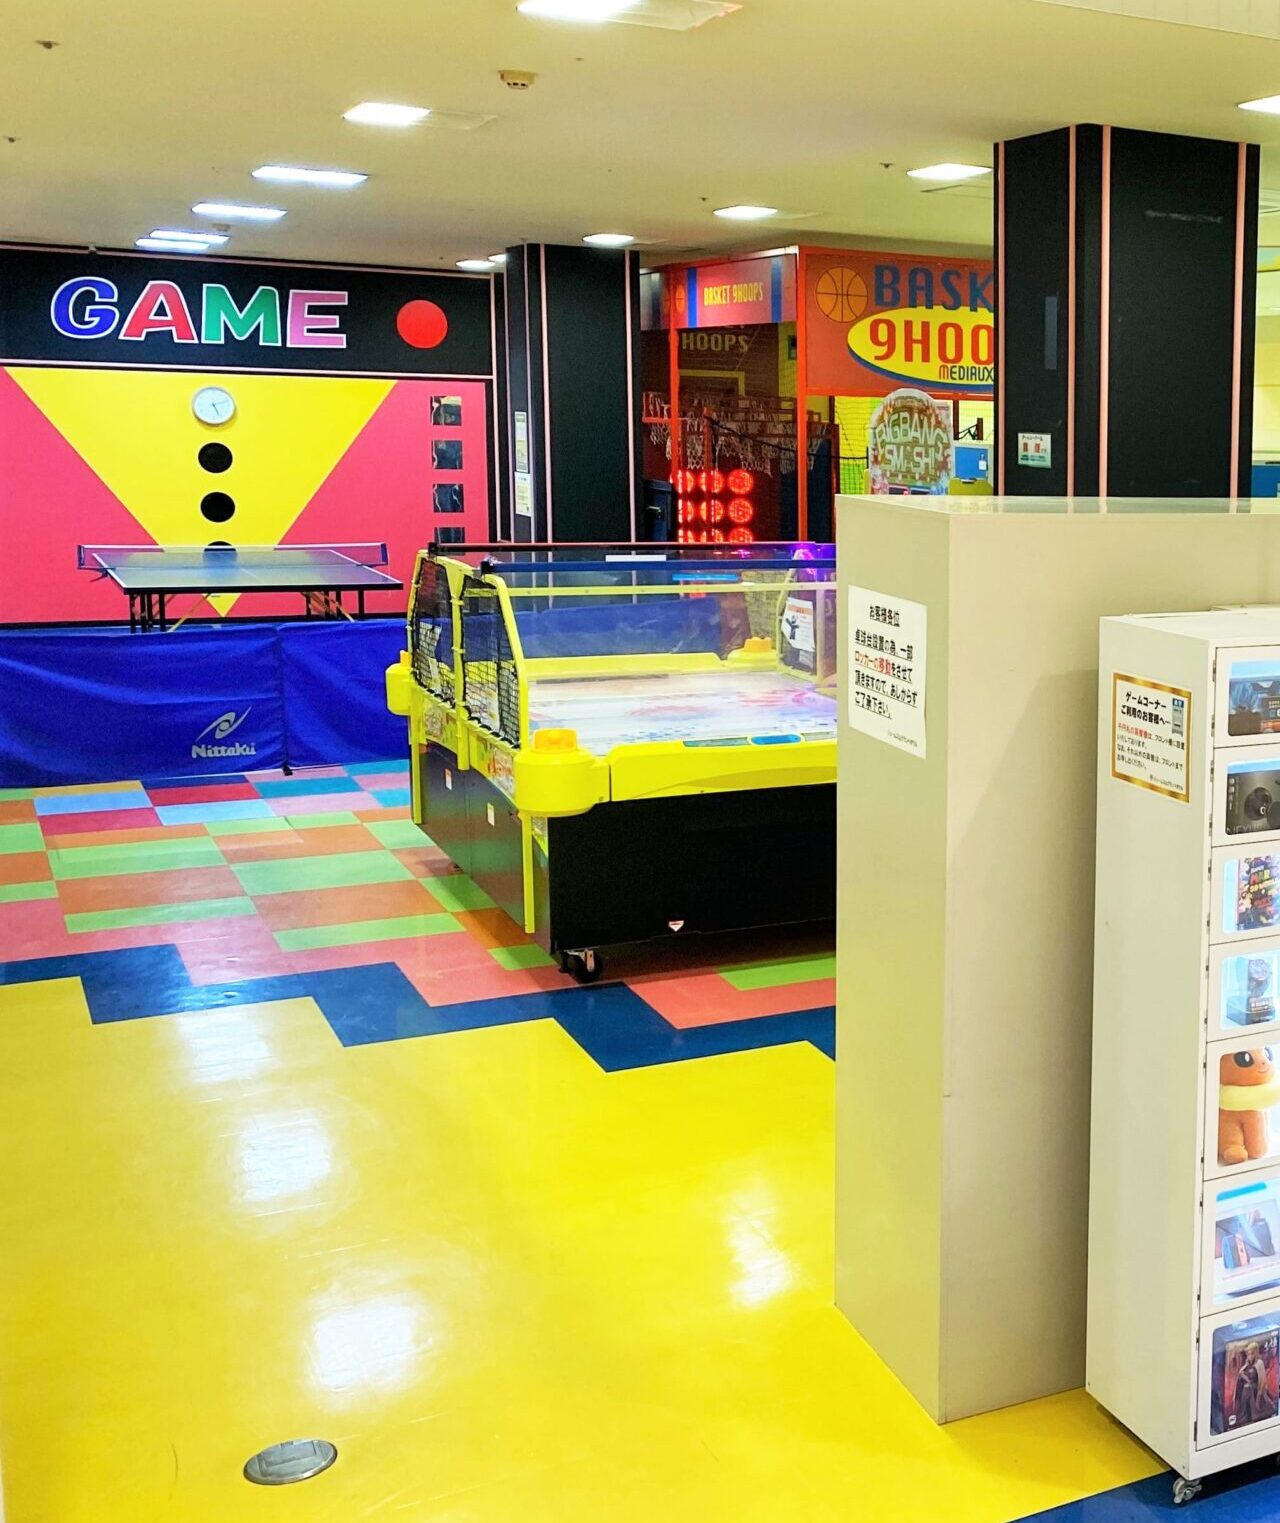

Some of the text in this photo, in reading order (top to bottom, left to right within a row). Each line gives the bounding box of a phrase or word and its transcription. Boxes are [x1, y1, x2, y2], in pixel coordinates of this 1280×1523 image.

[703, 281, 764, 307] BASKET 9HOOPS
[50, 276, 349, 349] GAME
[681, 332, 749, 352] HOOPS
[869, 605, 900, 628] お客様各位
[855, 650, 913, 682] ロッカーの移動をさせて
[855, 669, 918, 706] 頂きますので、あしからず
[1125, 691, 1167, 709] ゲームコーナー
[855, 690, 892, 719] ご了承下さい。
[191, 742, 257, 759] Nittaku
